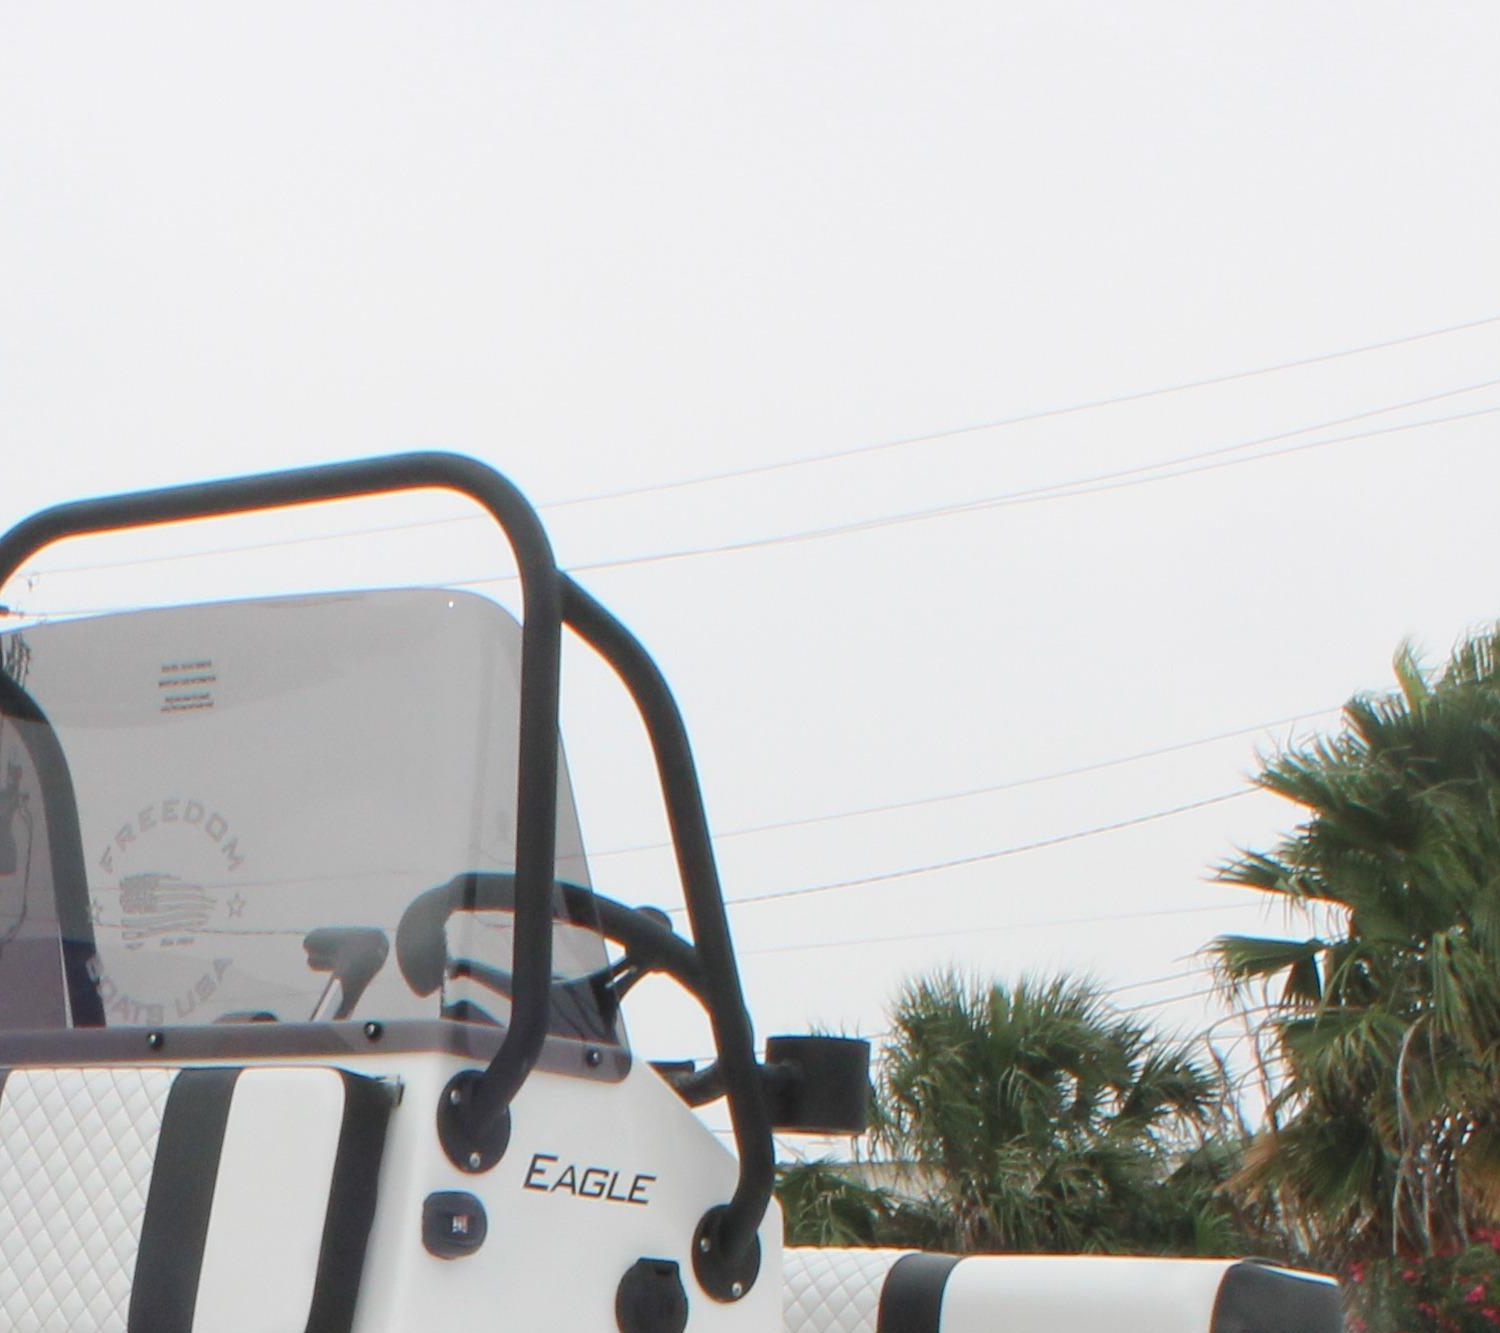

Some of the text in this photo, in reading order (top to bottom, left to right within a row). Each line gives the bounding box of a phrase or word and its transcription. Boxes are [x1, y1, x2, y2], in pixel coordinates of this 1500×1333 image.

[99, 798, 247, 875] FREEDOM
[174, 957, 235, 1019] USA
[522, 1152, 657, 1205] EAGLE
